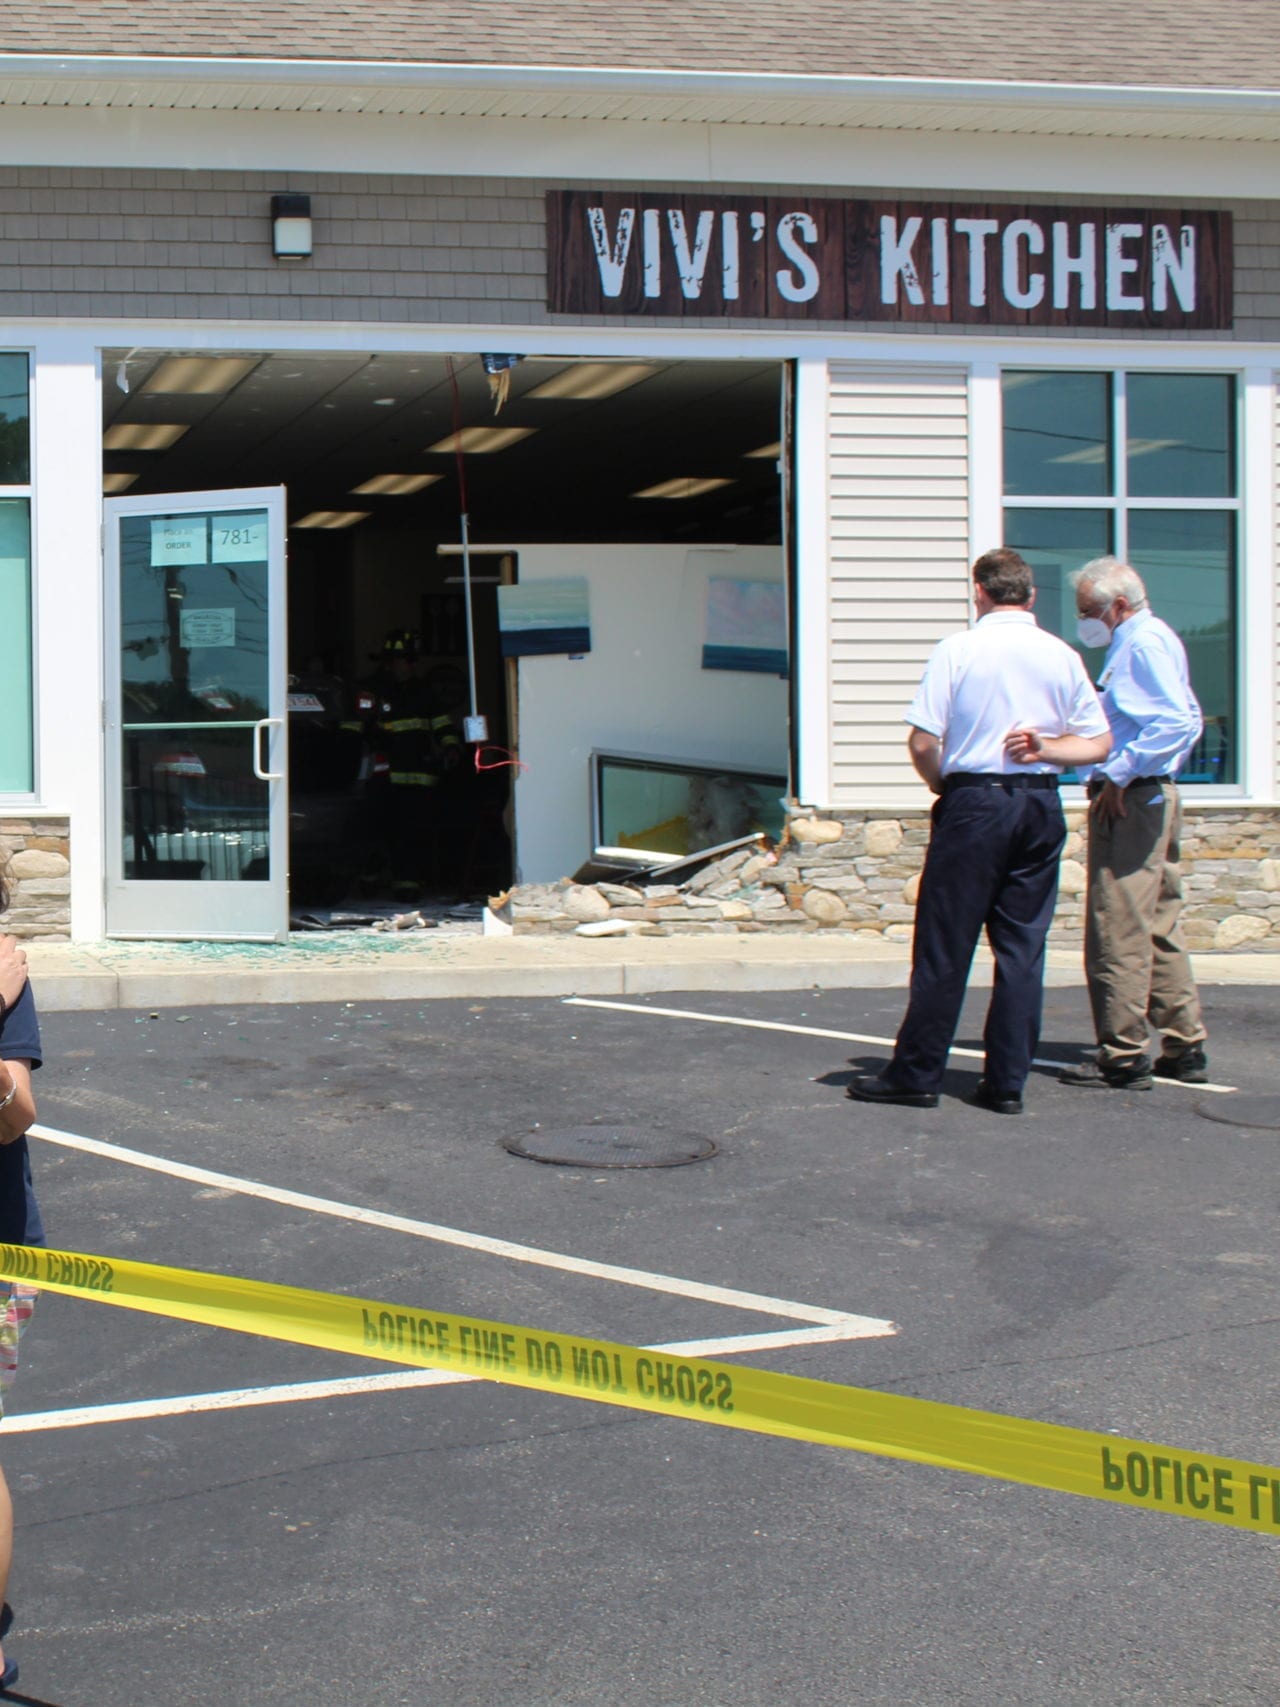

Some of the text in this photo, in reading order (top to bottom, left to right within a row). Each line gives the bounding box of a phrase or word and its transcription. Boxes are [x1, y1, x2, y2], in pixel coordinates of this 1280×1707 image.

[587, 207, 1197, 313] VIVI'S KITCHEN
[221, 529, 259, 545] 781-
[165, 541, 192, 550] ORDER
